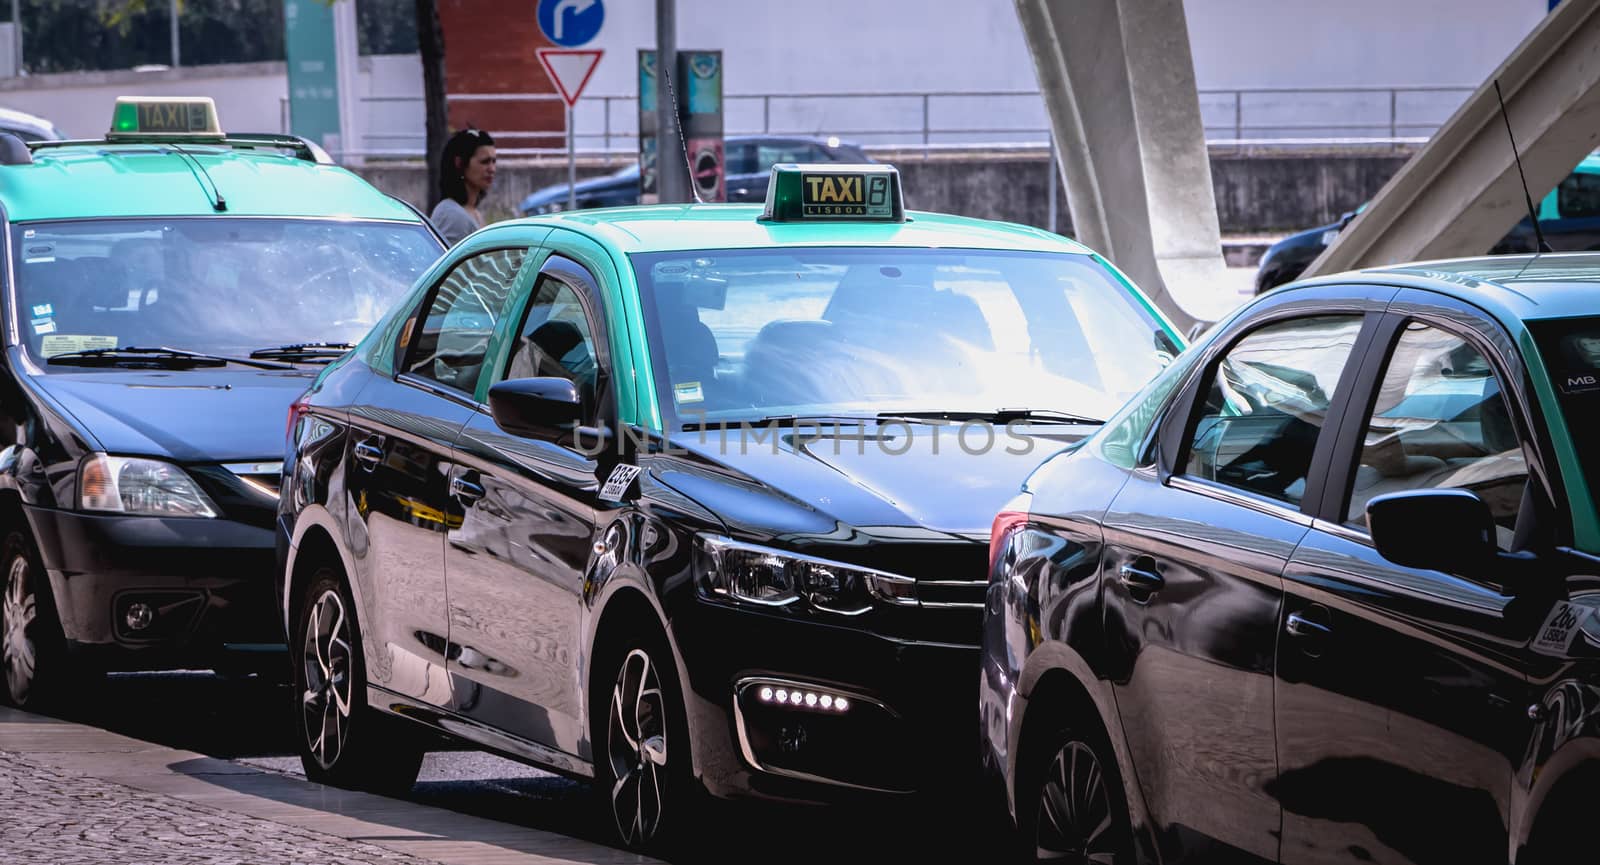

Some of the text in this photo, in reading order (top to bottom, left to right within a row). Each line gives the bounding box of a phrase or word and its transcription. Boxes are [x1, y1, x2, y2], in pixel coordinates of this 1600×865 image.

[143, 102, 186, 129] TAXI
[806, 176, 863, 203] TAXI
[807, 206, 863, 215] LISBOA
[1567, 376, 1597, 387] MB
